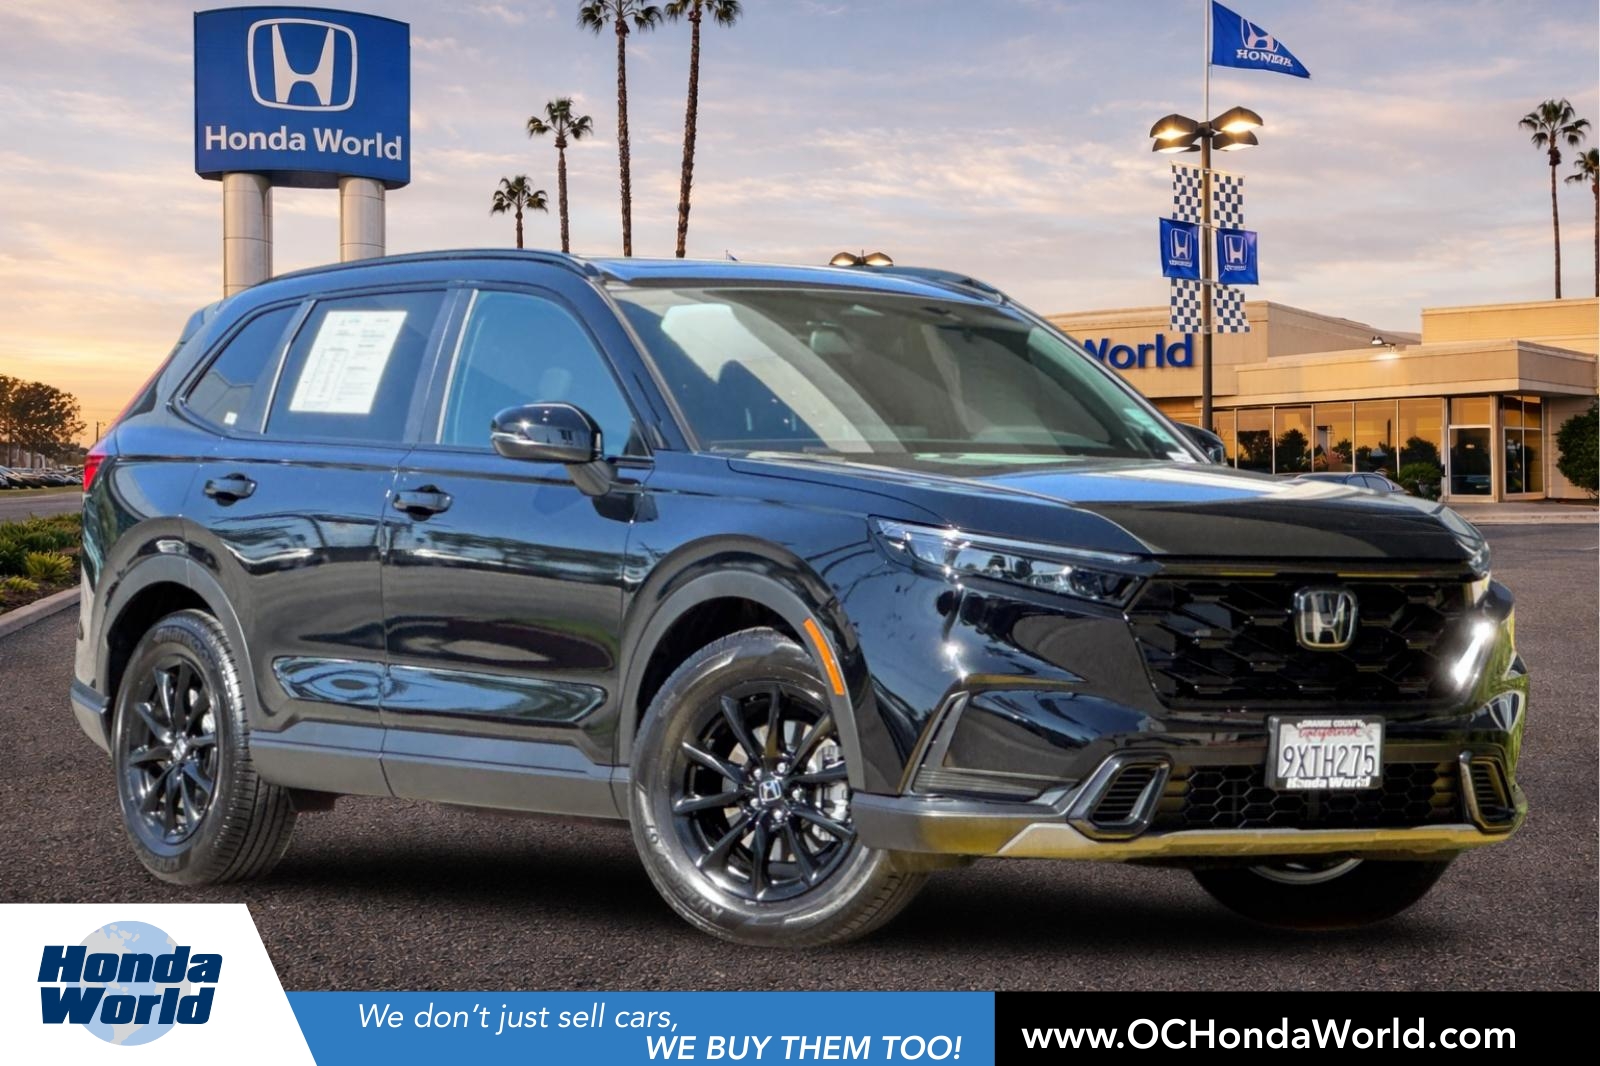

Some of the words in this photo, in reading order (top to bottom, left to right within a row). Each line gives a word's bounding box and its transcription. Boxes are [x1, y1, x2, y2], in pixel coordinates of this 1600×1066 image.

[205, 125, 306, 151] Honda
[313, 127, 402, 160] World
[1283, 744, 1375, 777] 9XTH275
